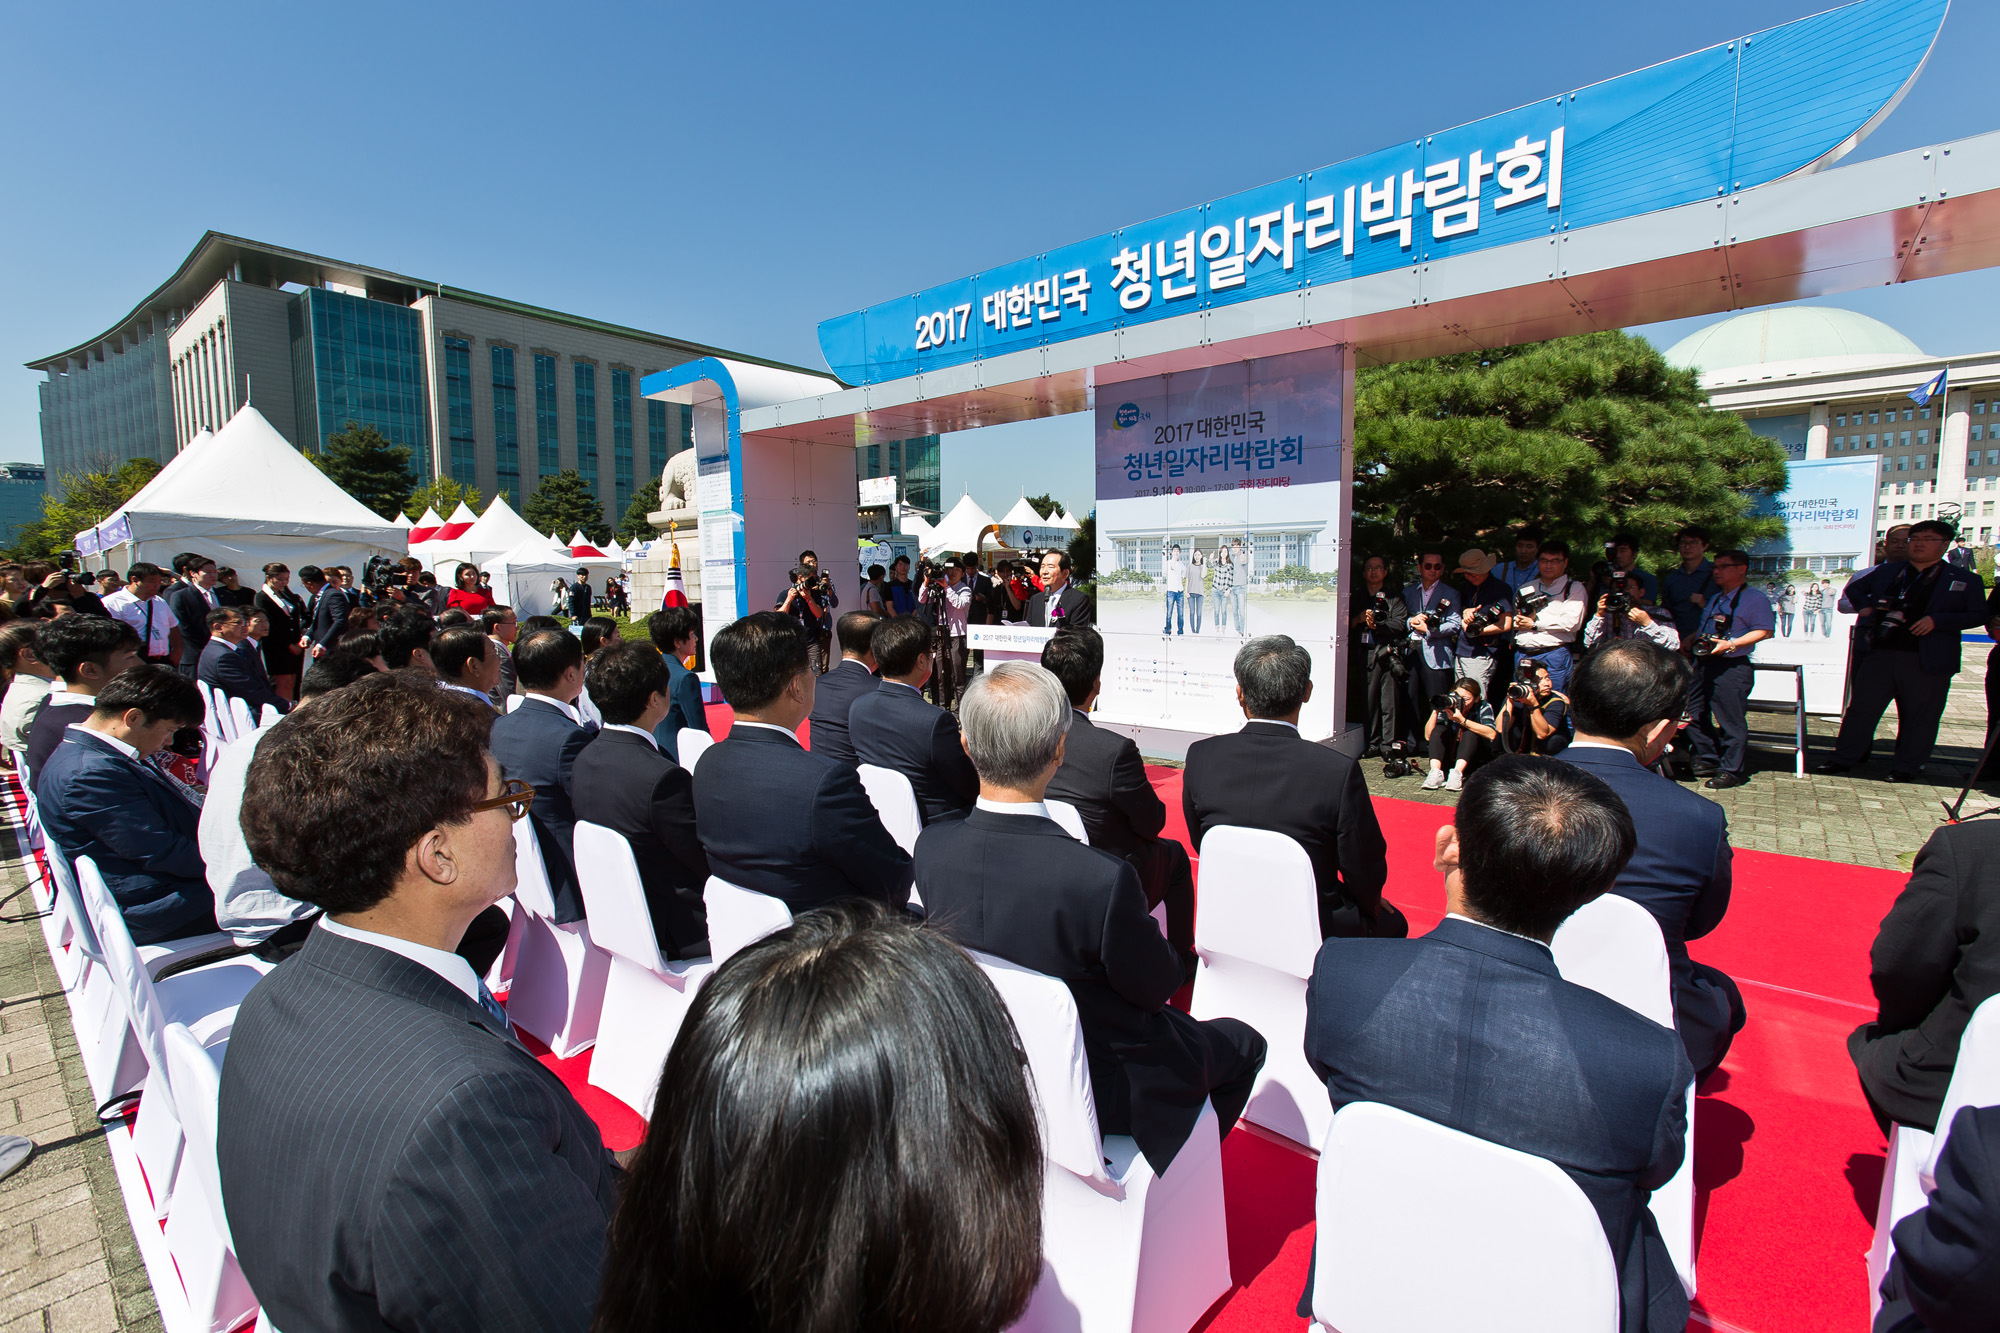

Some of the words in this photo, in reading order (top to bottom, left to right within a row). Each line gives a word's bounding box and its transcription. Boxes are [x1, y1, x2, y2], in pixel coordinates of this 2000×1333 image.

[915, 303, 972, 350] 2017
[982, 268, 1092, 330] 대한민국
[1109, 126, 1565, 310] 청년일자리박람회
[1154, 423, 1194, 445] 2017
[1197, 410, 1266, 439] 대한민국
[1123, 434, 1303, 481] 청년일자리박람회
[1185, 485, 1206, 494] 10:00
[1214, 482, 1235, 491] 17:00
[1238, 479, 1255, 490] 국회
[1256, 476, 1291, 489] 잔디마당
[1772, 501, 1797, 511] 2017
[1798, 498, 1838, 509] 대한민국
